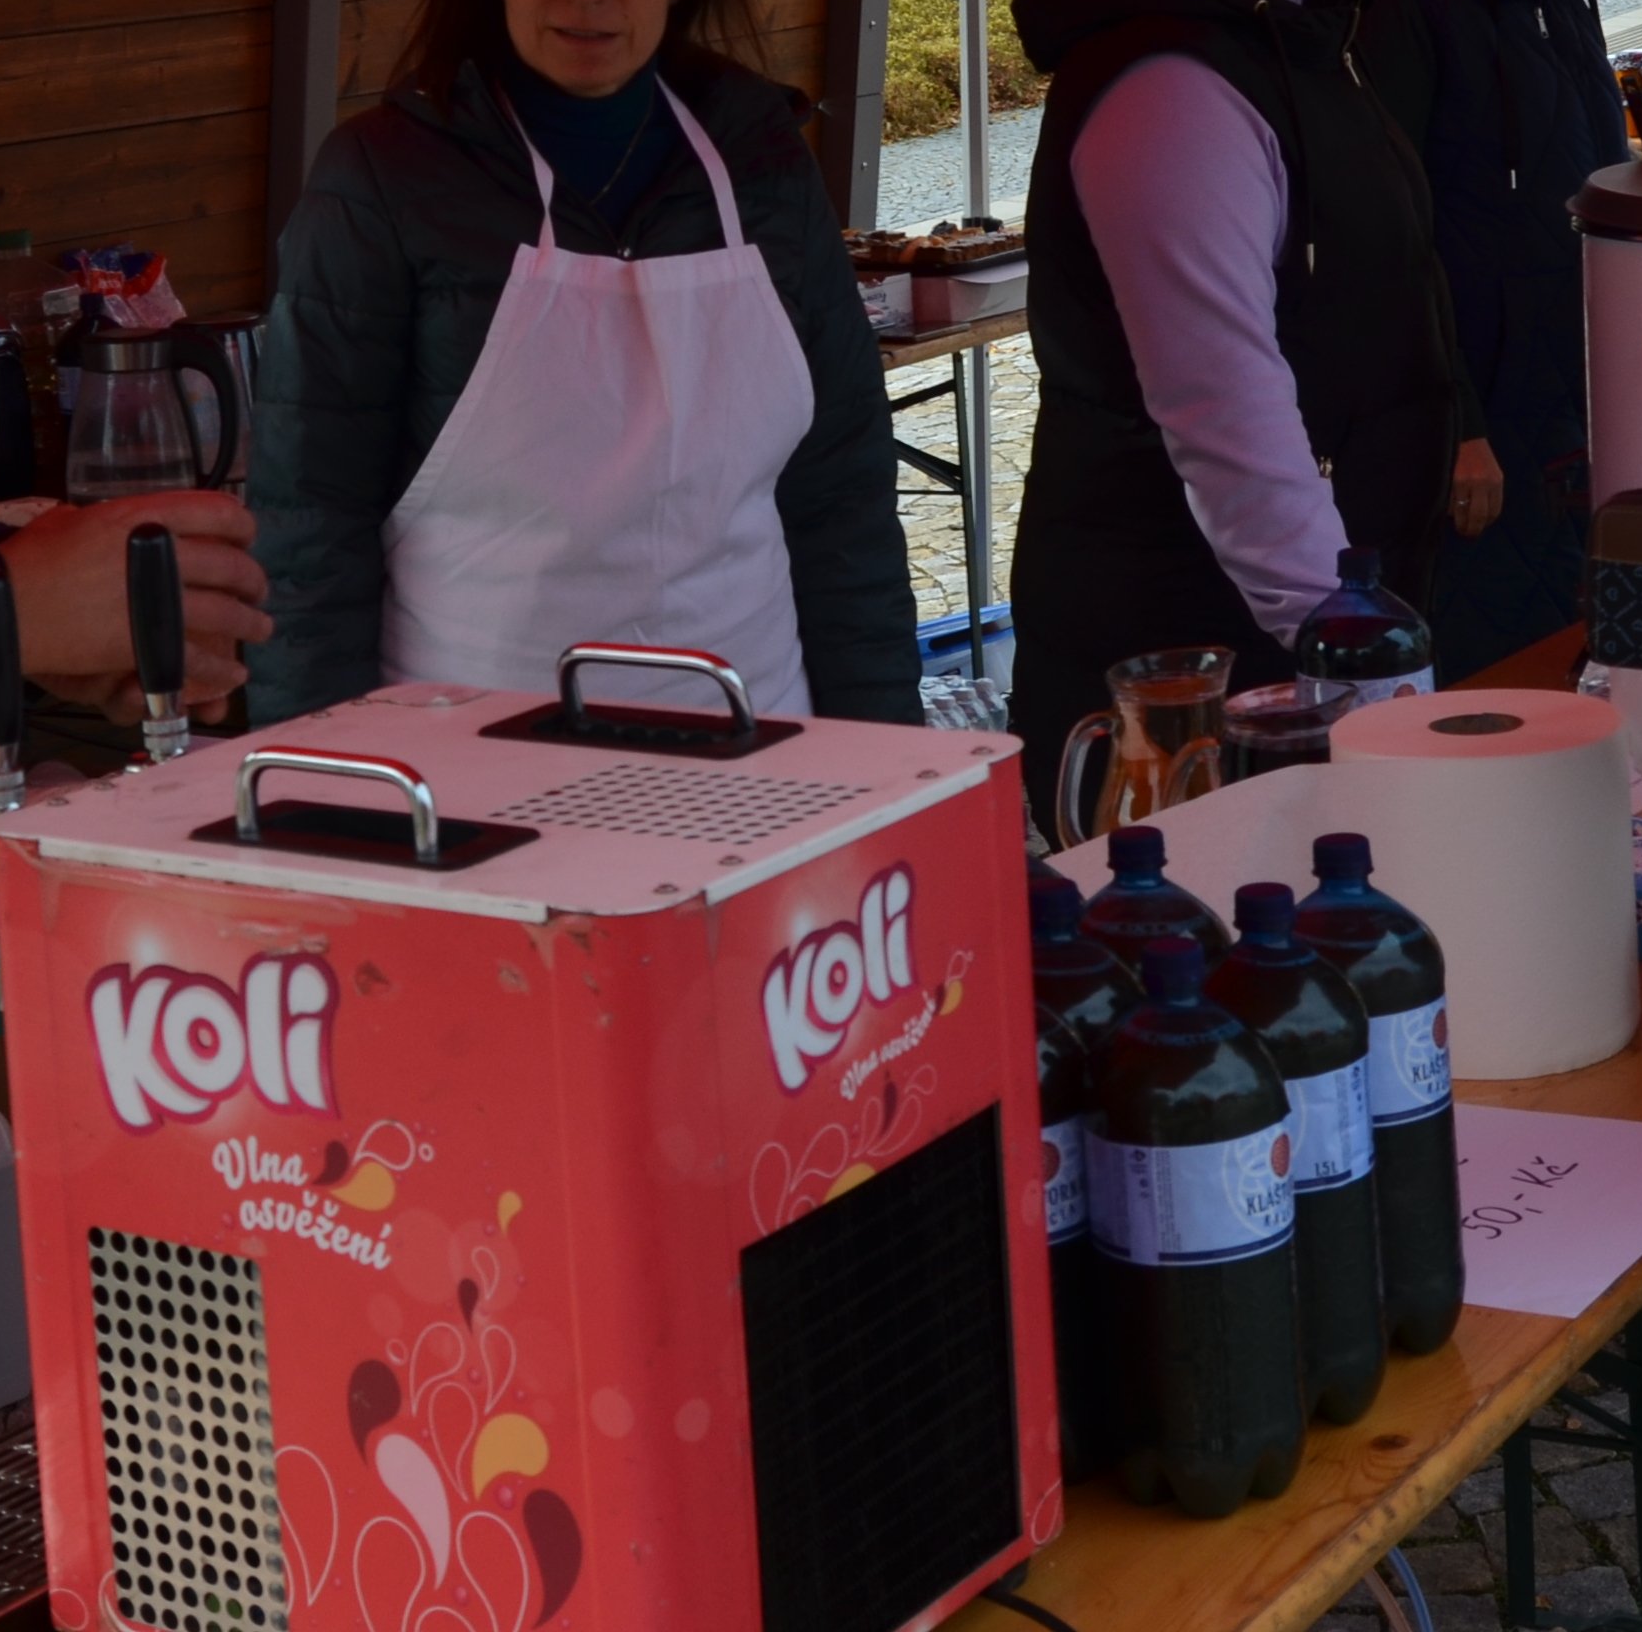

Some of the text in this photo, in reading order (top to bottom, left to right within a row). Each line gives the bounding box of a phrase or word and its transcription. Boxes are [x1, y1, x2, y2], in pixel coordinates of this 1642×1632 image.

[761, 867, 915, 1093] Koli
[90, 958, 335, 1128] Koli
[212, 1136, 308, 1190] Vlna
[1510, 1155, 1579, 1188] Kč
[239, 1190, 392, 1270] osvěžení
